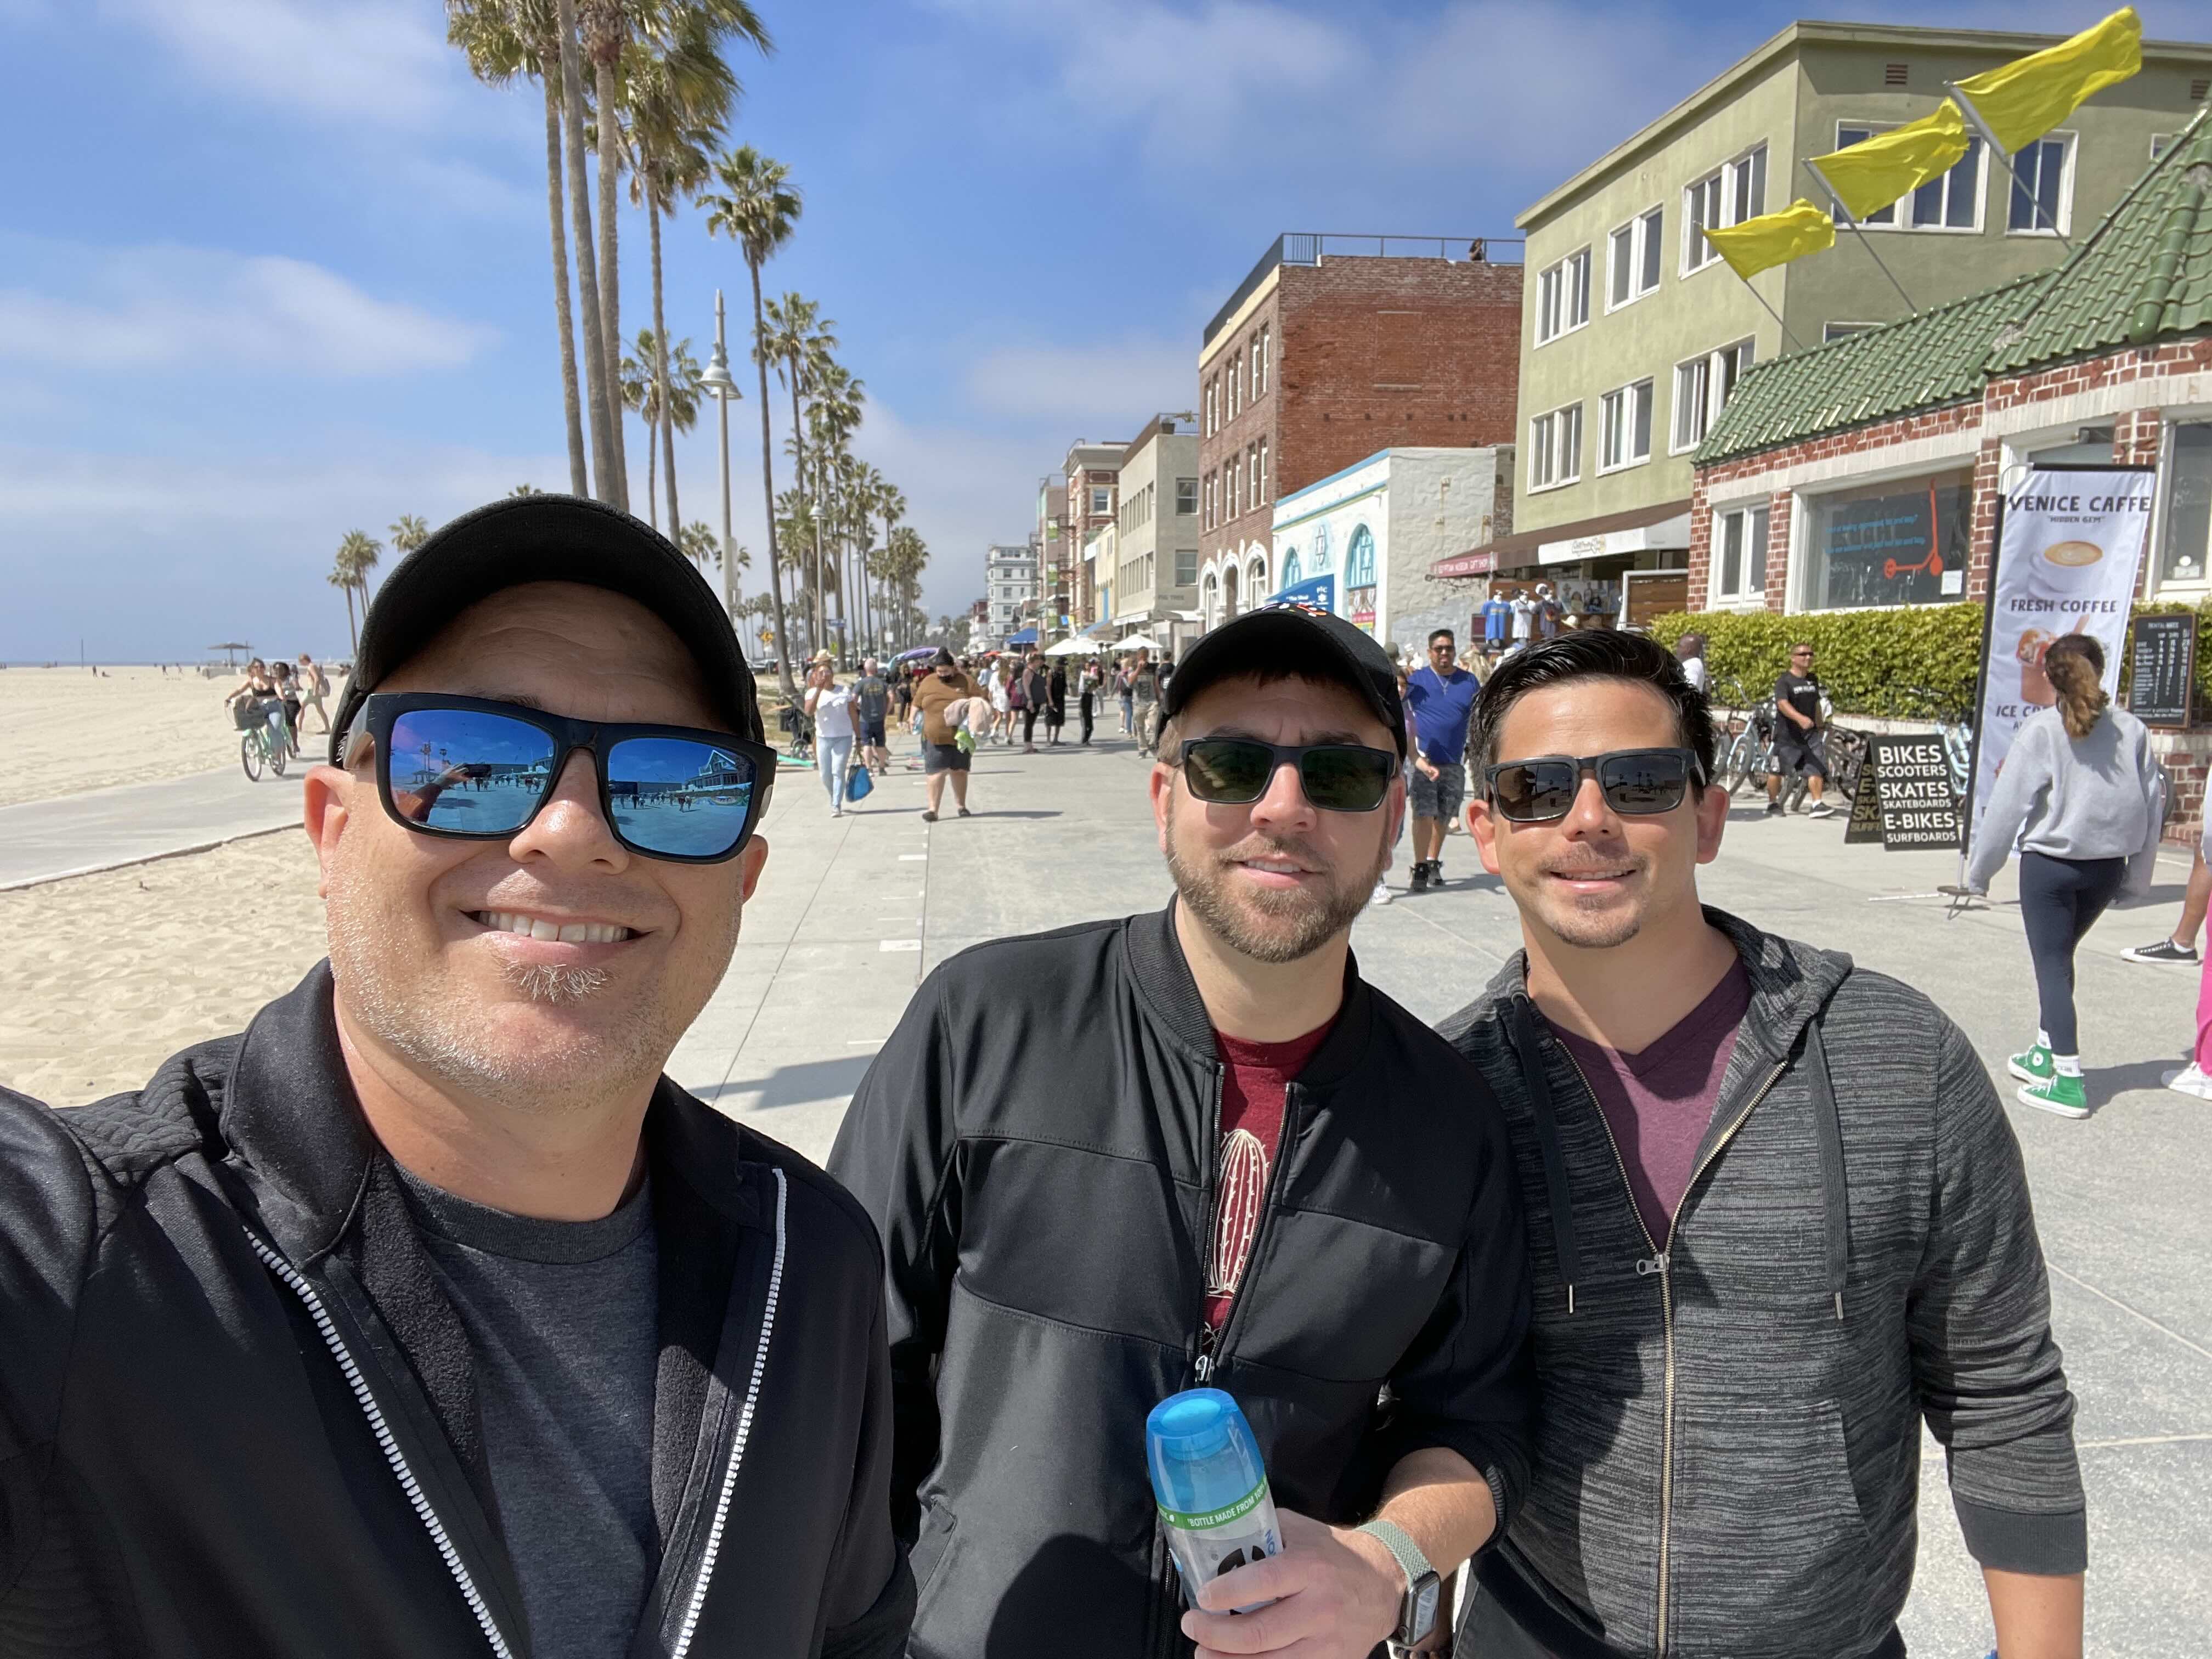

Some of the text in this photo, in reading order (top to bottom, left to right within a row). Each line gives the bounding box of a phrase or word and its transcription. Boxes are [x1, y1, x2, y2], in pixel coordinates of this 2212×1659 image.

[2009, 495, 2151, 512] VENICE CAFFE
[2011, 599, 2118, 613] FRESH COFFEE
[1995, 705, 2017, 718] ICE
[1879, 744, 1942, 764] BIKES
[1877, 764, 1948, 778] SCOOTERS
[1880, 781, 1949, 799] SKATES
[1882, 799, 1952, 810] SKATEBOARDS
[1884, 812, 1955, 830] E-BIKES
[1886, 831, 1957, 843] SURFBOARDS
[1215, 1508, 1237, 1523] MADE
[1236, 1496, 1255, 1514] FROM
